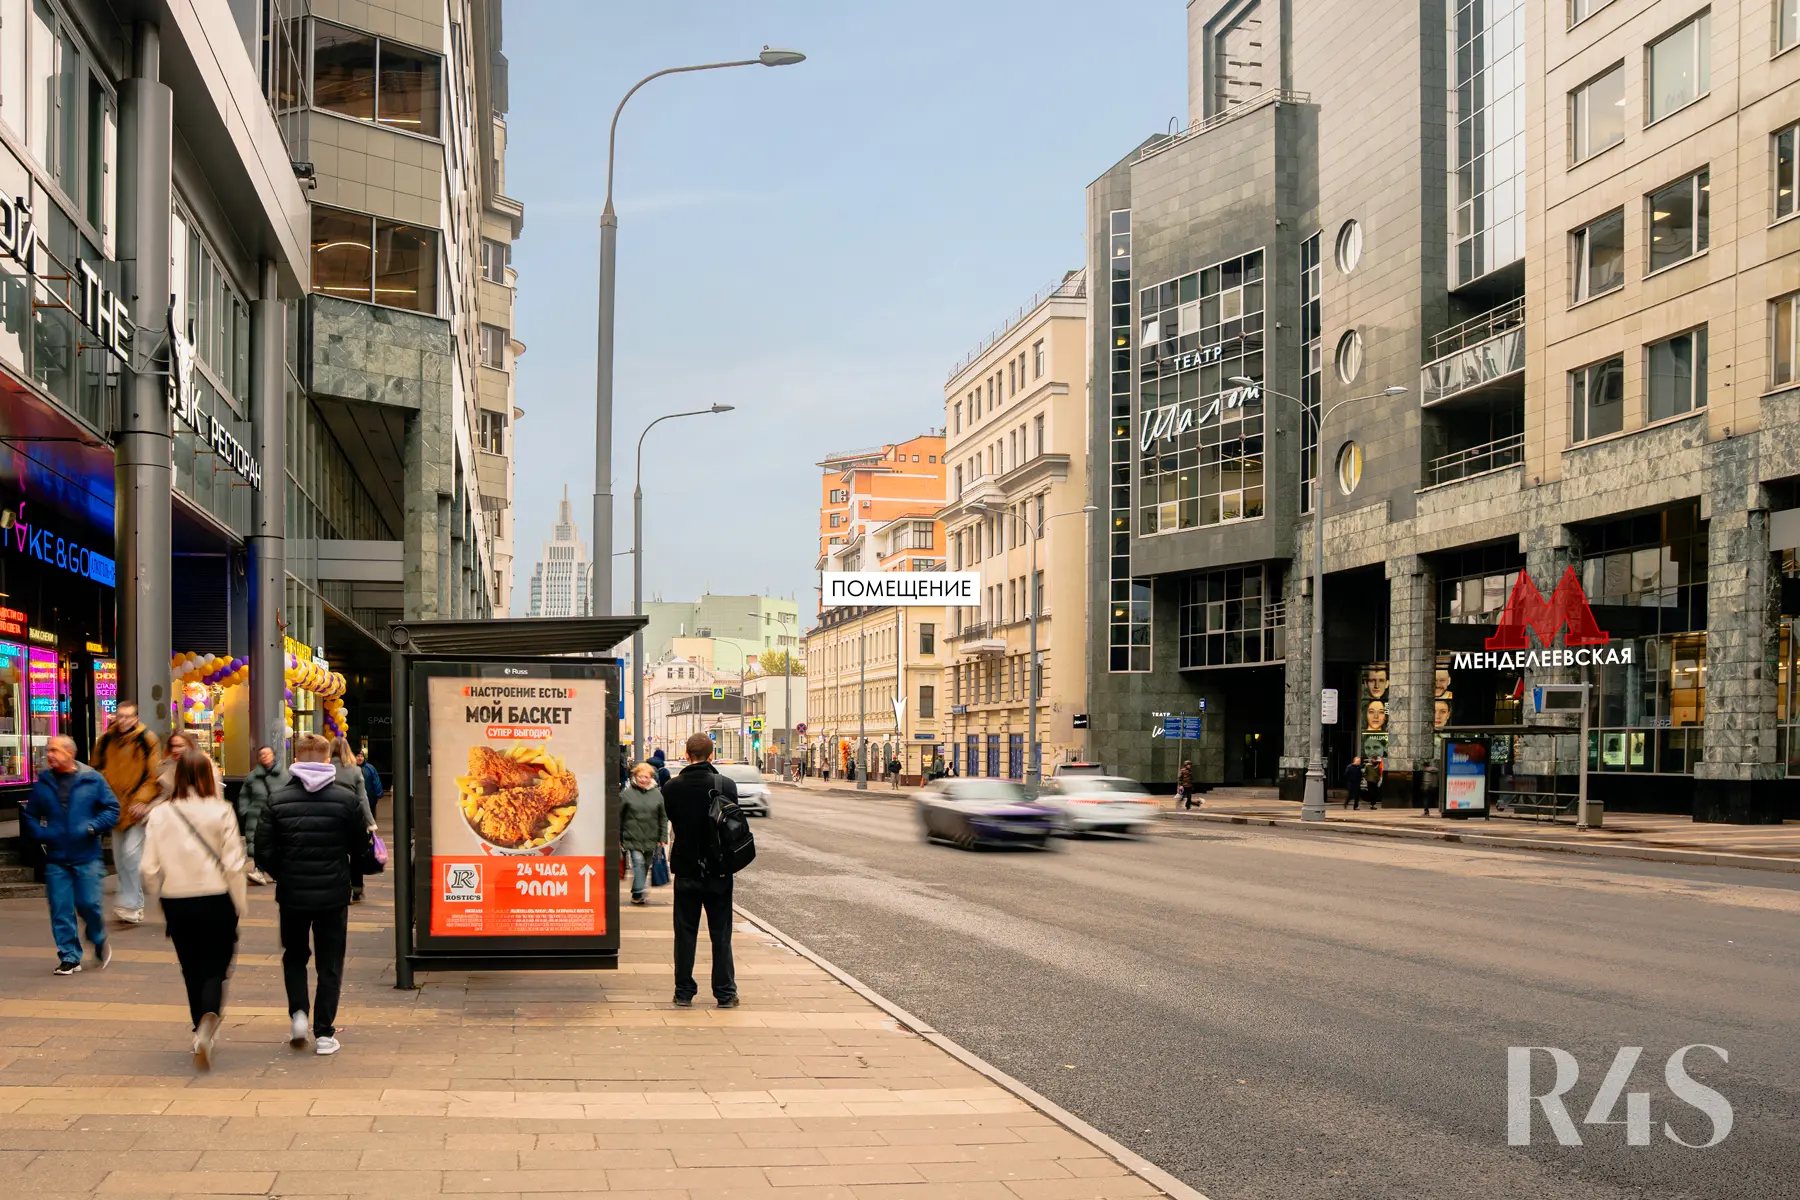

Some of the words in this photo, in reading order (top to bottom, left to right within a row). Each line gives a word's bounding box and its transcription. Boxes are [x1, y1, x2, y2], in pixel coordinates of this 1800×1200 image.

[1173, 346, 1224, 372] ТЕАТР
[75, 257, 129, 363] THE
[207, 415, 262, 492] РЕСТОРАН
[1140, 384, 1260, 452] Шалом
[470, 686, 536, 699] НАСТРОЕНИЕ
[539, 686, 568, 698] ЕСТЬ!
[367, 716, 393, 725] SPAC
[466, 700, 503, 724] МОЙ
[508, 706, 572, 725] БАСКЕТ
[488, 727, 512, 737] СУПЕР
[514, 727, 552, 738] ВЫГОДНО
[516, 863, 533, 876] 24
[535, 863, 568, 876] ЧАСА
